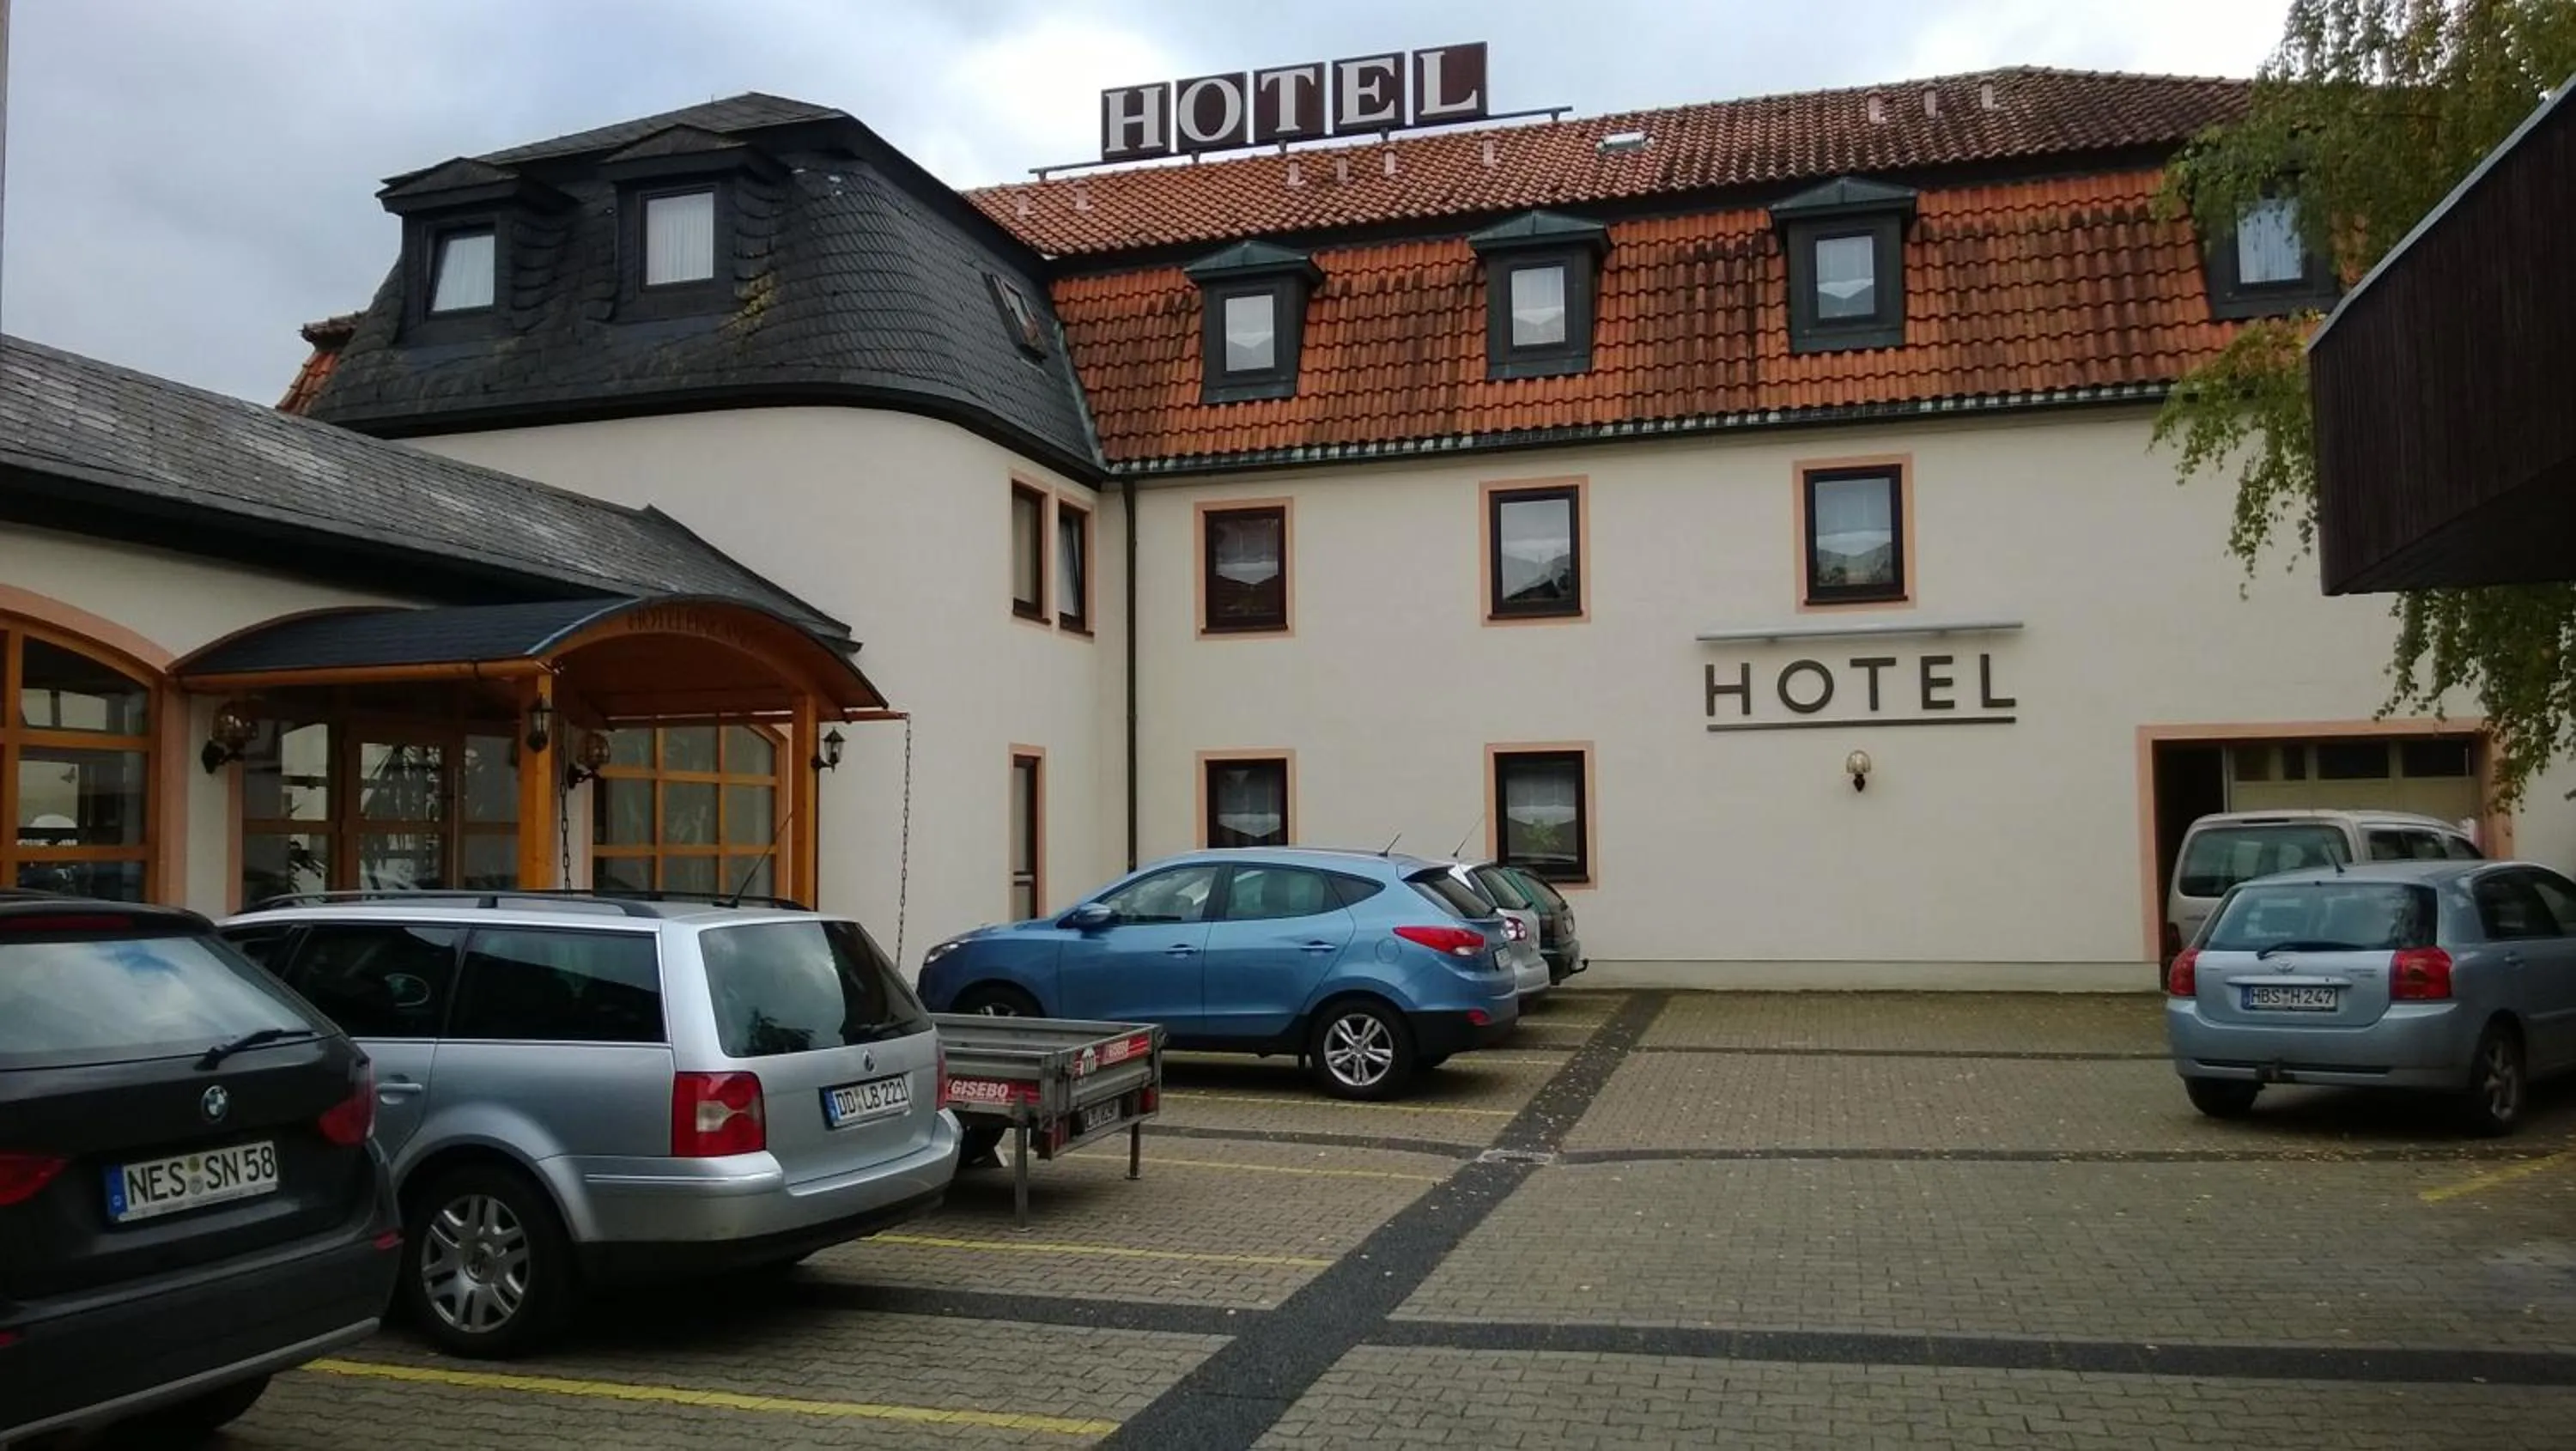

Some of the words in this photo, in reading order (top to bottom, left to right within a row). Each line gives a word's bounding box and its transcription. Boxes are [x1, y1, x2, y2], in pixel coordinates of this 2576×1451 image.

[1105, 50, 1479, 153] HOTEL
[1704, 653, 2017, 717] HOTEL
[2251, 988, 2281, 1004] HBS
[2304, 989, 2334, 1005] 247
[951, 1079, 1009, 1100] GISEBO
[127, 1160, 186, 1206] NES
[204, 1150, 241, 1190] SN
[244, 1145, 276, 1182] 58
